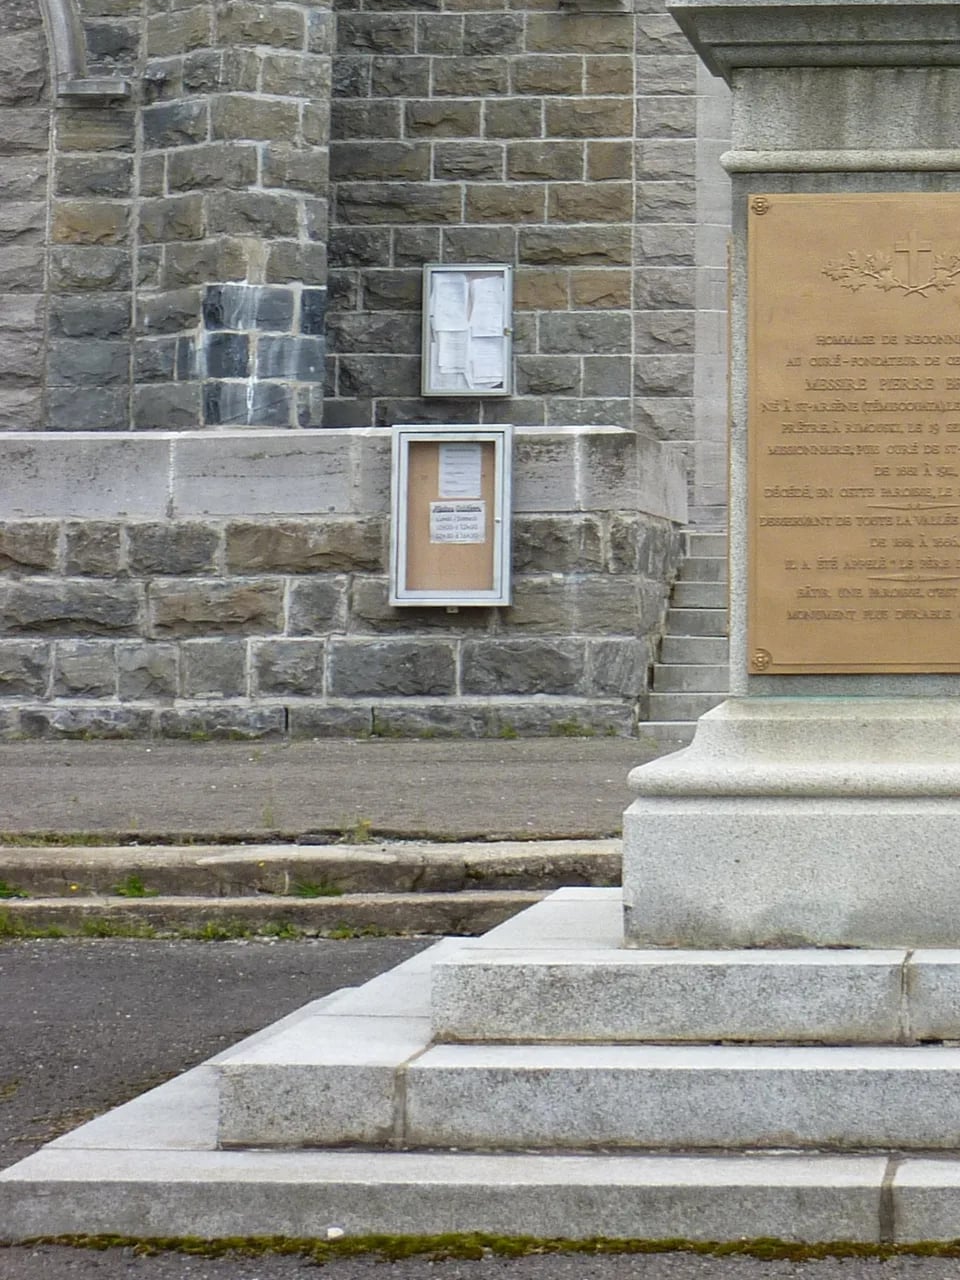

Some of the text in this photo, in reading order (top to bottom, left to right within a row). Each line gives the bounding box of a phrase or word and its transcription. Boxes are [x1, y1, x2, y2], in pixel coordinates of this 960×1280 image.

[816, 335, 875, 345] HOMMAGE
[881, 335, 898, 345] DE
[786, 356, 800, 367] AU
[924, 356, 940, 366] DE
[805, 377, 867, 391] MESSIRE
[879, 377, 934, 391] PIERRE
[761, 399, 779, 412] NÉ
[782, 398, 792, 412] À
[908, 423, 923, 433] LE
[856, 445, 880, 454] PUIS
[886, 441, 918, 454] CURÉ
[924, 444, 940, 454] DE
[874, 465, 891, 476] DE
[923, 462, 932, 476] À
[817, 487, 833, 497] EN
[840, 487, 875, 497] CETTE
[938, 487, 952, 497] LE
[760, 516, 833, 527] DESSERVANT
[836, 516, 852, 527] DE
[856, 516, 893, 527] TOUTE
[896, 516, 912, 526] LA
[914, 512, 959, 526] VALLÉE
[870, 537, 887, 548] DE
[919, 533, 928, 548] À
[784, 560, 797, 570] IL
[801, 560, 811, 570] A
[816, 556, 838, 570] ÉTÉ
[843, 556, 887, 570] APPELÉ
[838, 588, 863, 598] UNE
[786, 609, 856, 620] MONUMENT
[895, 609, 951, 620] DURABLE
